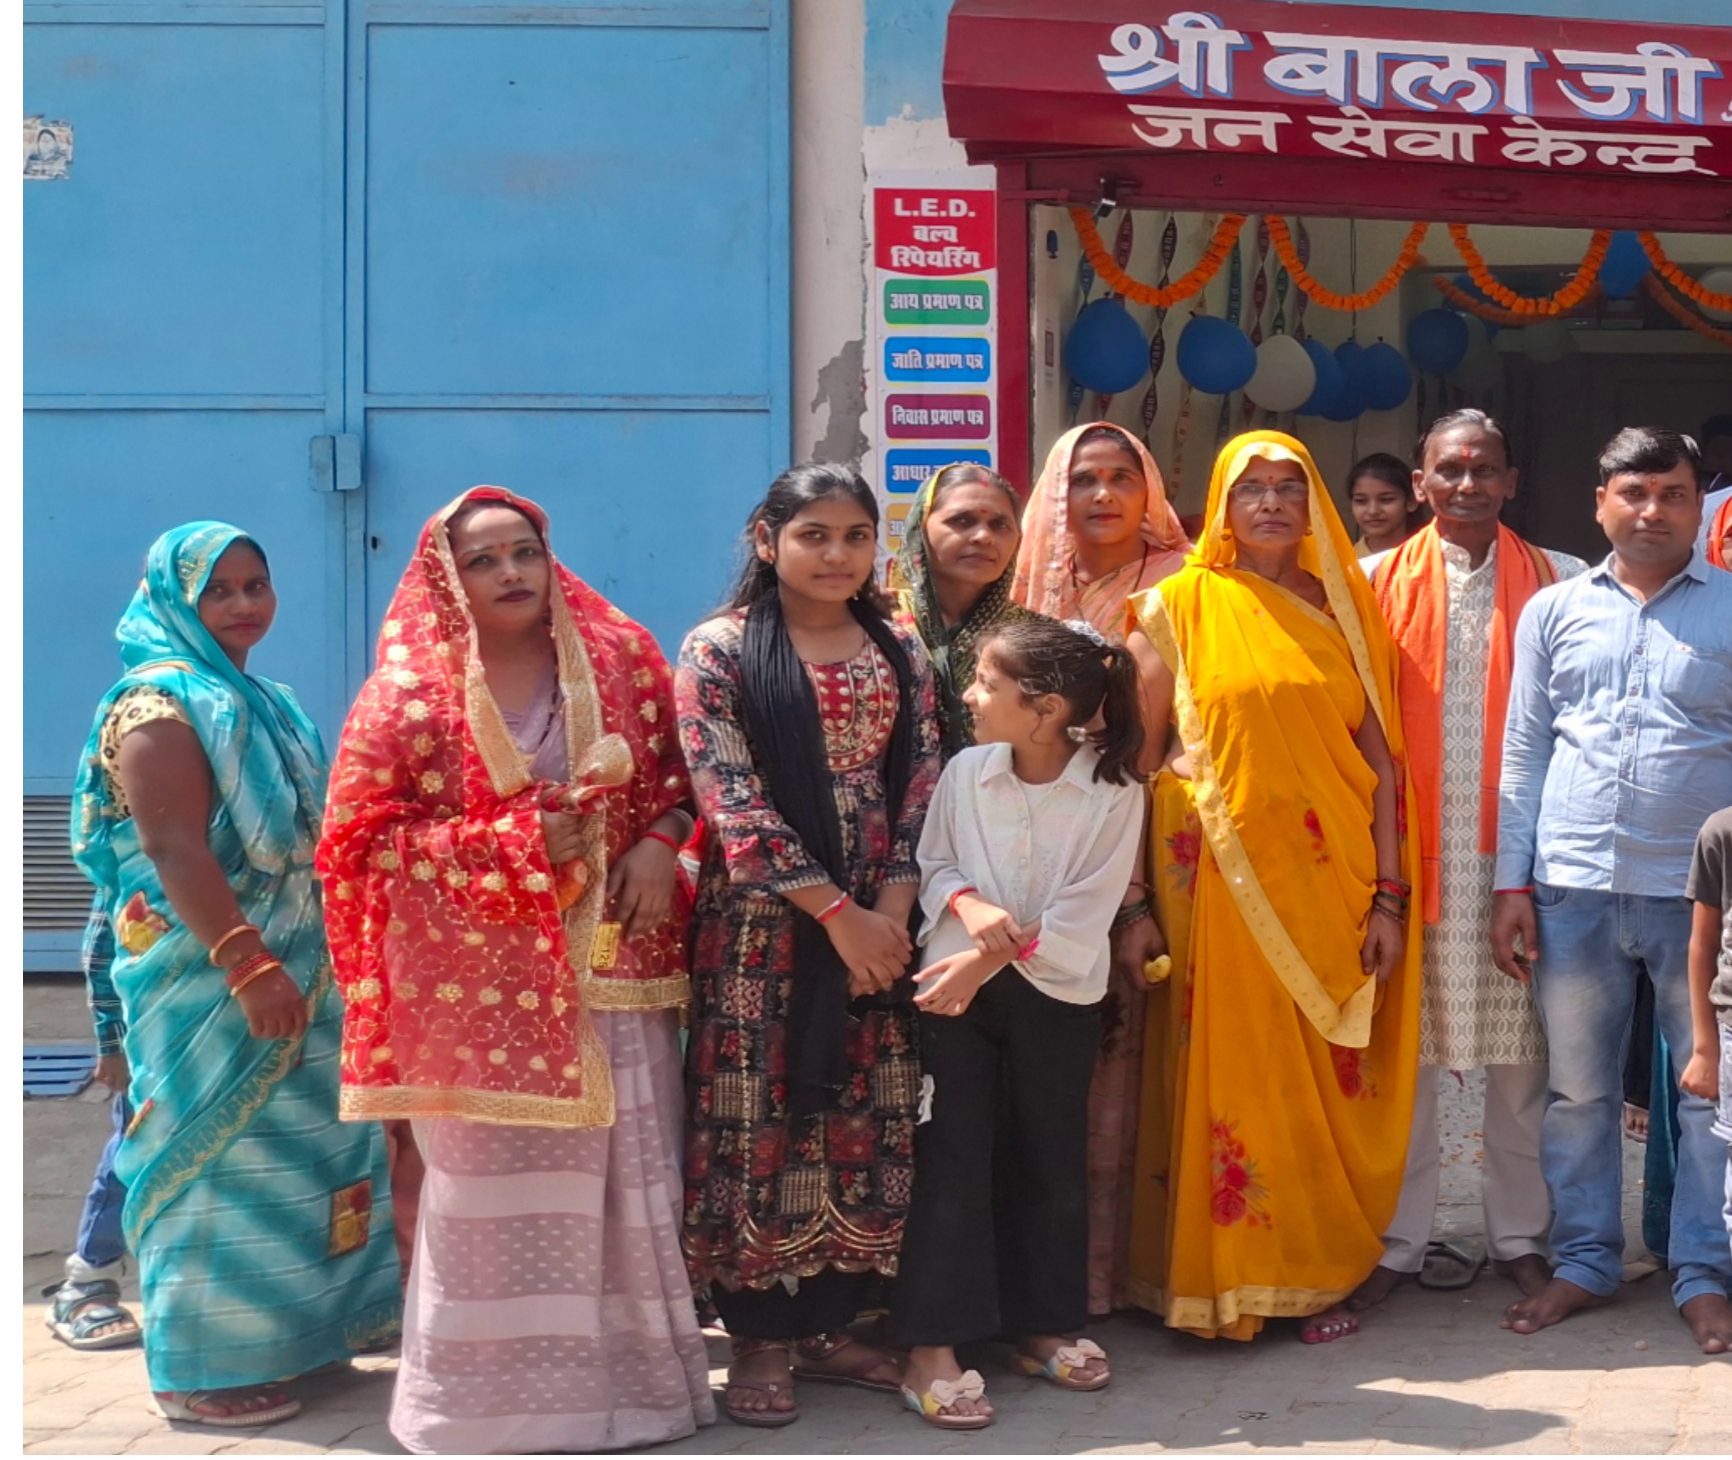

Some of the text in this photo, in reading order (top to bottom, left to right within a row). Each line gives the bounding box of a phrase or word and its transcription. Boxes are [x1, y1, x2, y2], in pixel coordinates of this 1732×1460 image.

[1098, 11, 1722, 125] श्री बाला जी
[1127, 104, 1718, 176] जन सेवा केन्द्र
[894, 197, 976, 217] L.E.D.
[890, 245, 981, 268] रिपेयरिंग
[890, 293, 984, 310] आय प्रमाण पत्र
[891, 348, 984, 370] जाति प्रमाण पत्र
[892, 405, 984, 426] निवास प्रमाण पत्र
[892, 464, 931, 481] आधार
